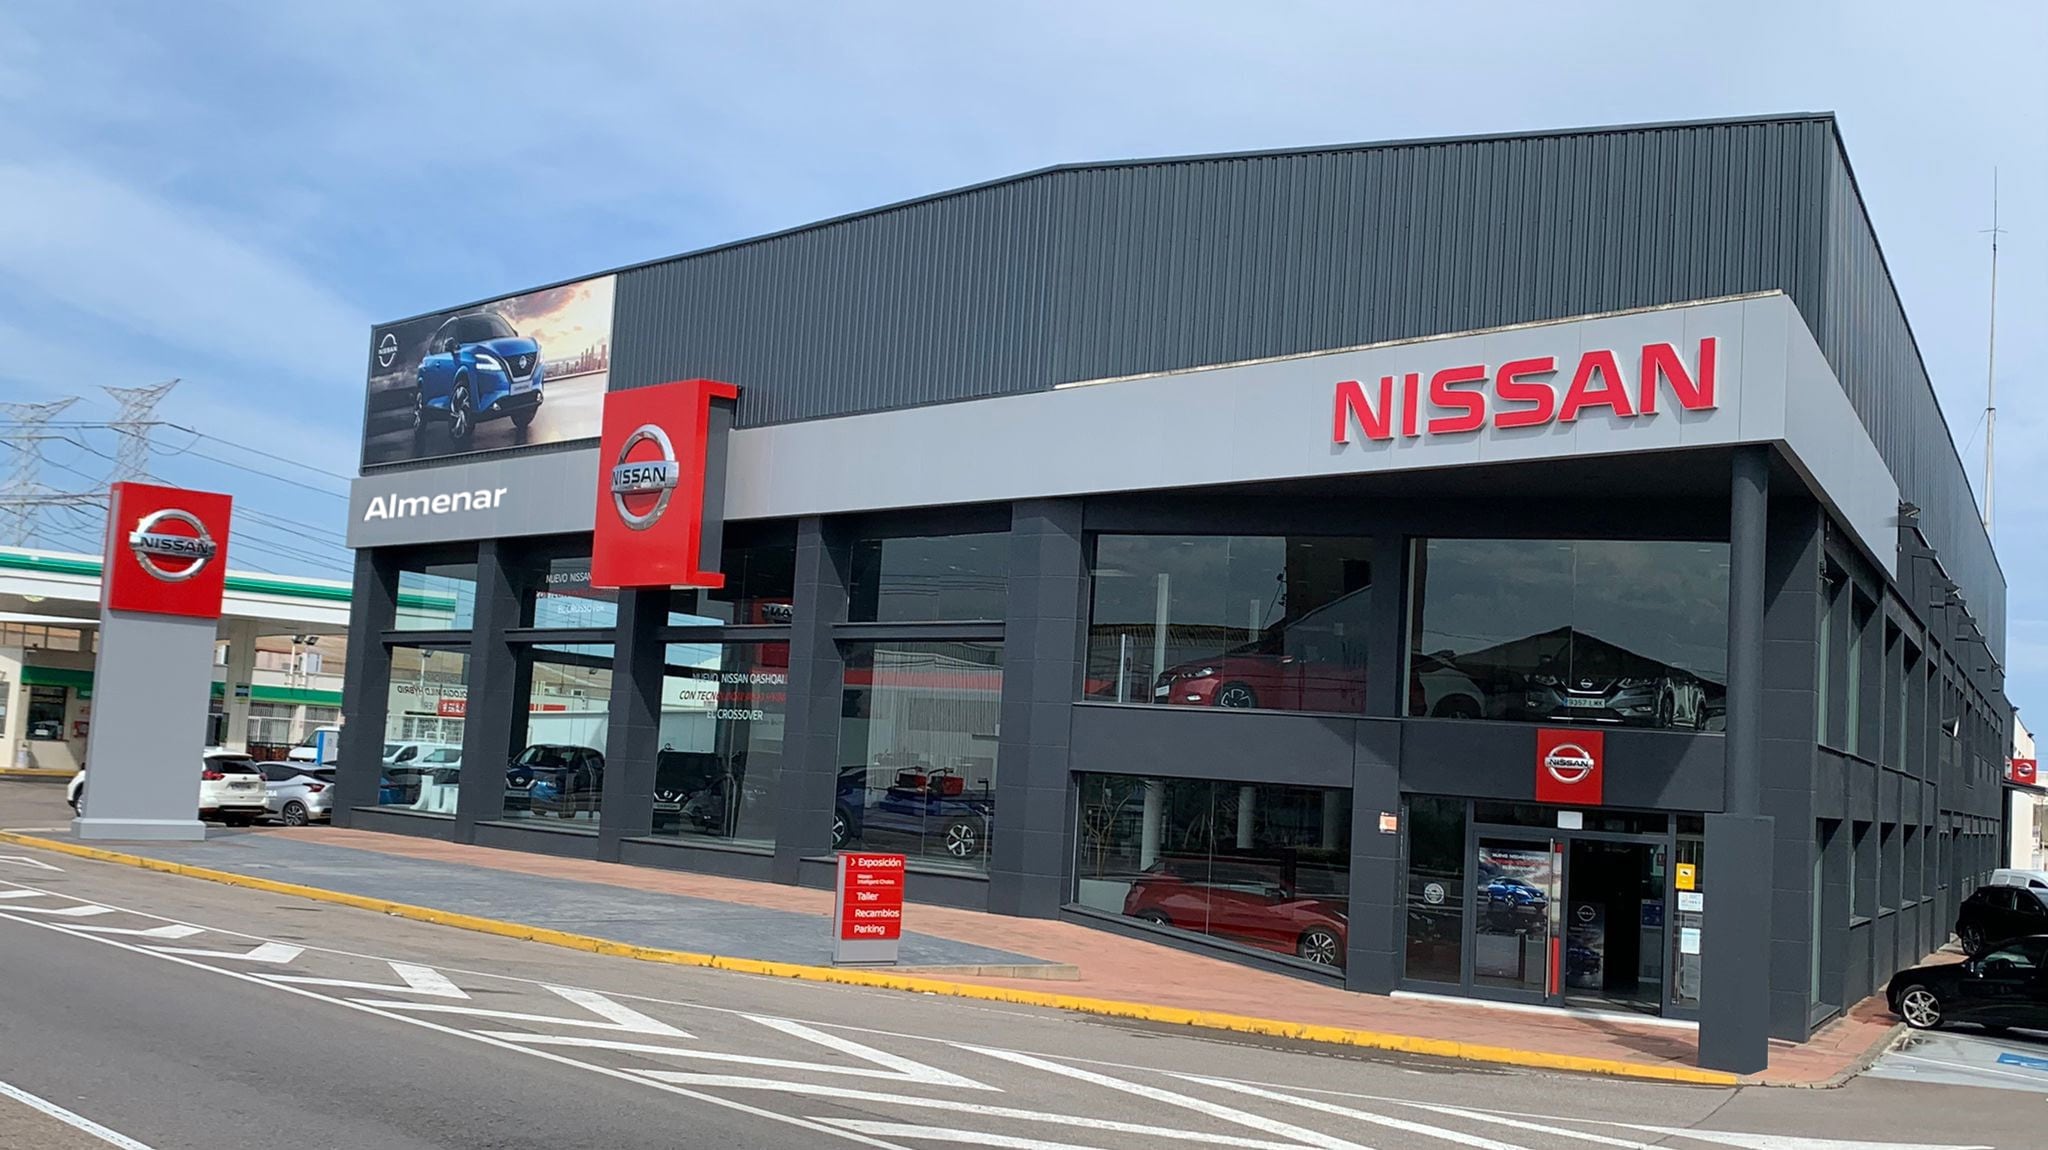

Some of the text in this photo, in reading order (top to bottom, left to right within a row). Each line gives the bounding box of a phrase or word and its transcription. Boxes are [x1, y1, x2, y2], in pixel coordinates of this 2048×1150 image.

[1332, 336, 1720, 444] NISSAN
[611, 466, 667, 486] NISSAN
[363, 487, 508, 521] Almenar
[140, 536, 209, 554] NISSAN
[545, 573, 568, 583] NUEVO
[721, 672, 749, 684] NISSAN
[679, 690, 695, 700] CON
[706, 709, 763, 720] EL CROSSOVER
[1549, 758, 1589, 767] NISSAN
[858, 857, 902, 868] Exposición
[856, 891, 880, 901] Taller
[854, 908, 900, 918] Recambios
[853, 924, 886, 936] Parking
